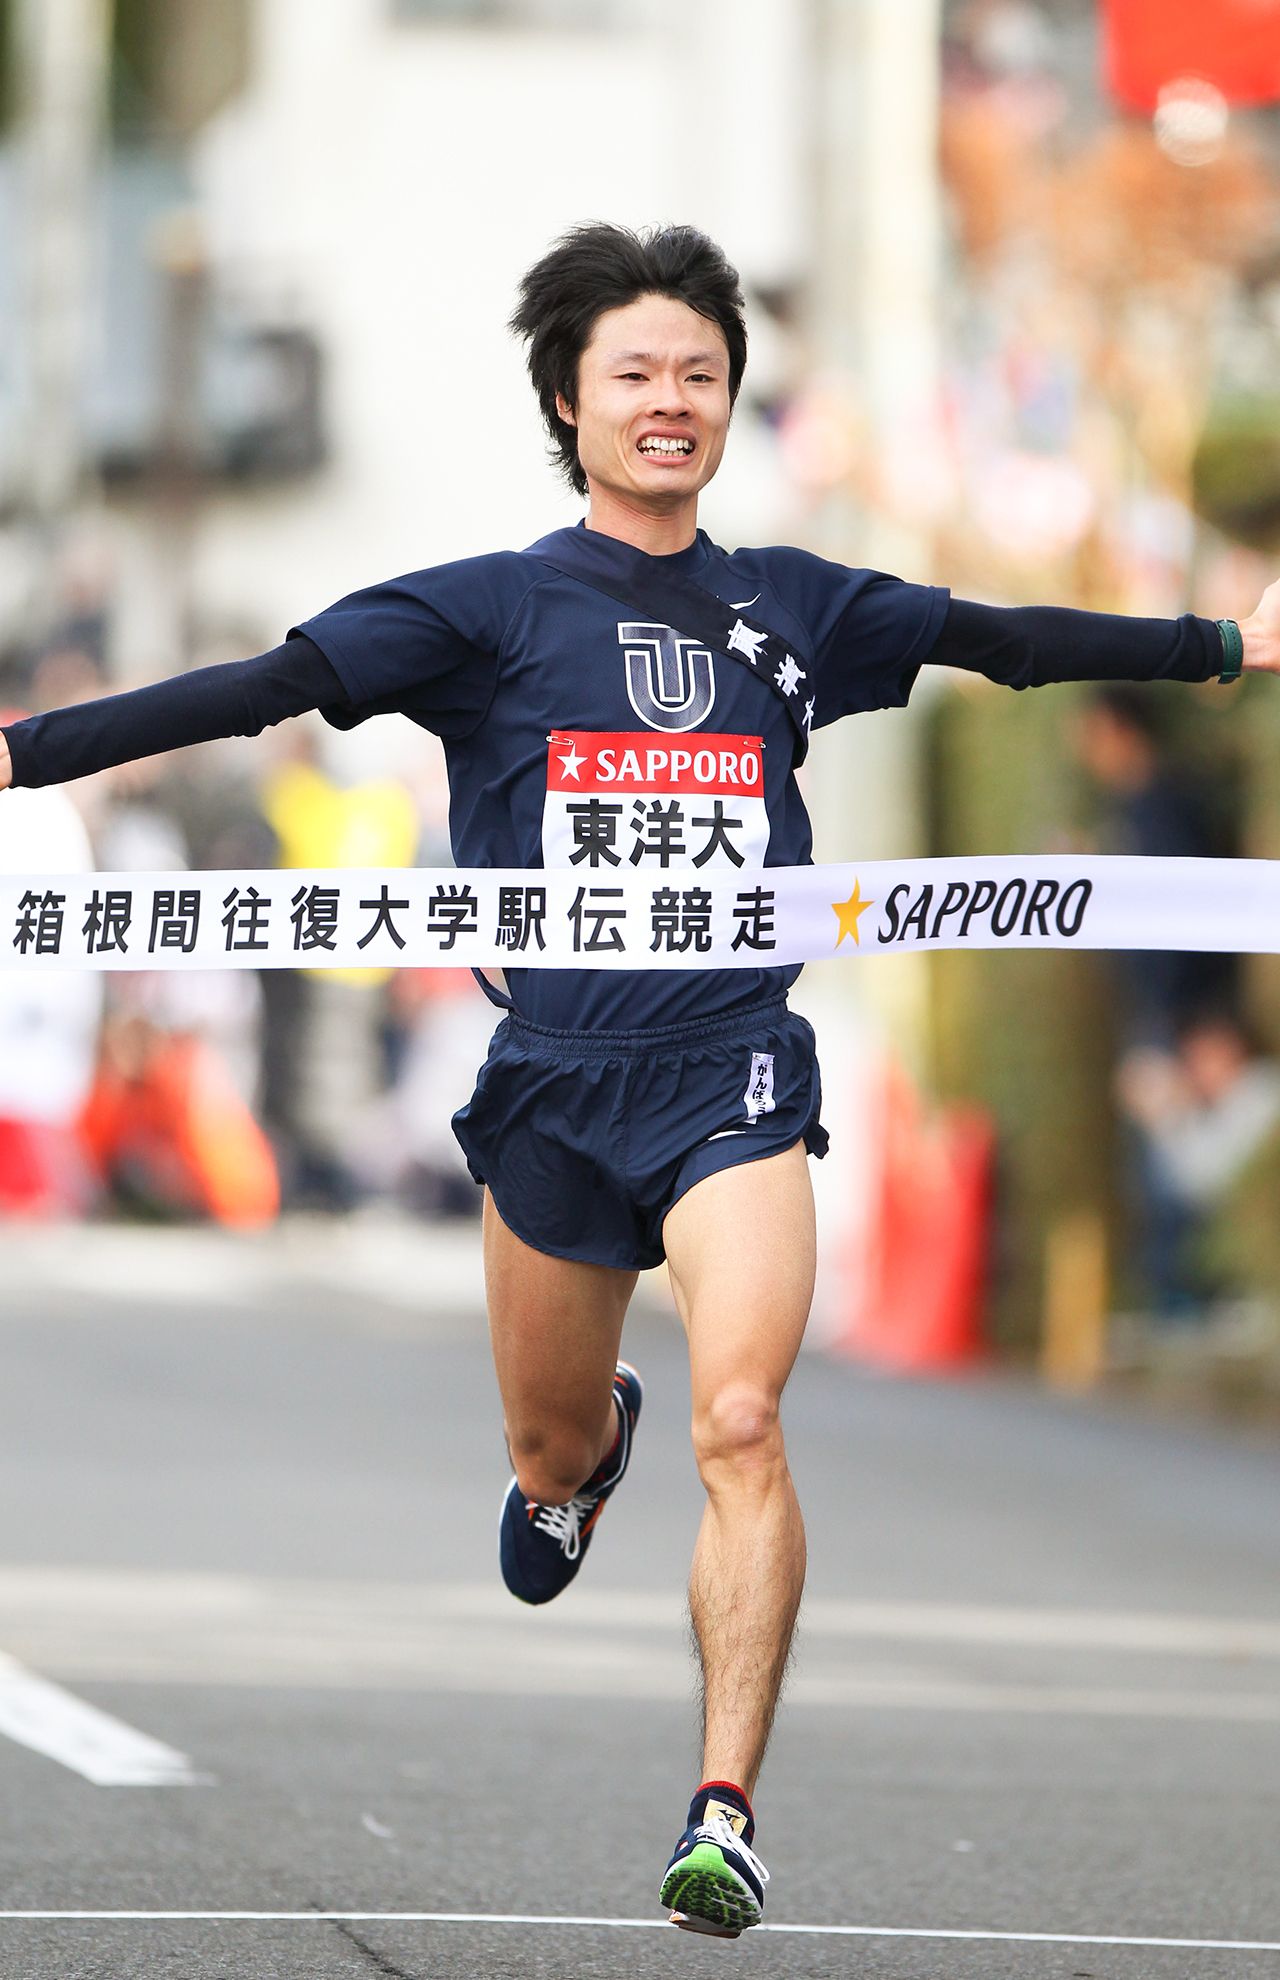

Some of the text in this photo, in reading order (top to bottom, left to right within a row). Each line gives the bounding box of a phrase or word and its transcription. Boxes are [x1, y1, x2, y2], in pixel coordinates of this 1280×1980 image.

[595, 748, 759, 785] SAPPORO
[566, 798, 746, 868] 東洋大
[12, 884, 777, 955] 箱根間往復大学駅伝競走
[876, 878, 1093, 944] SAPPORO
